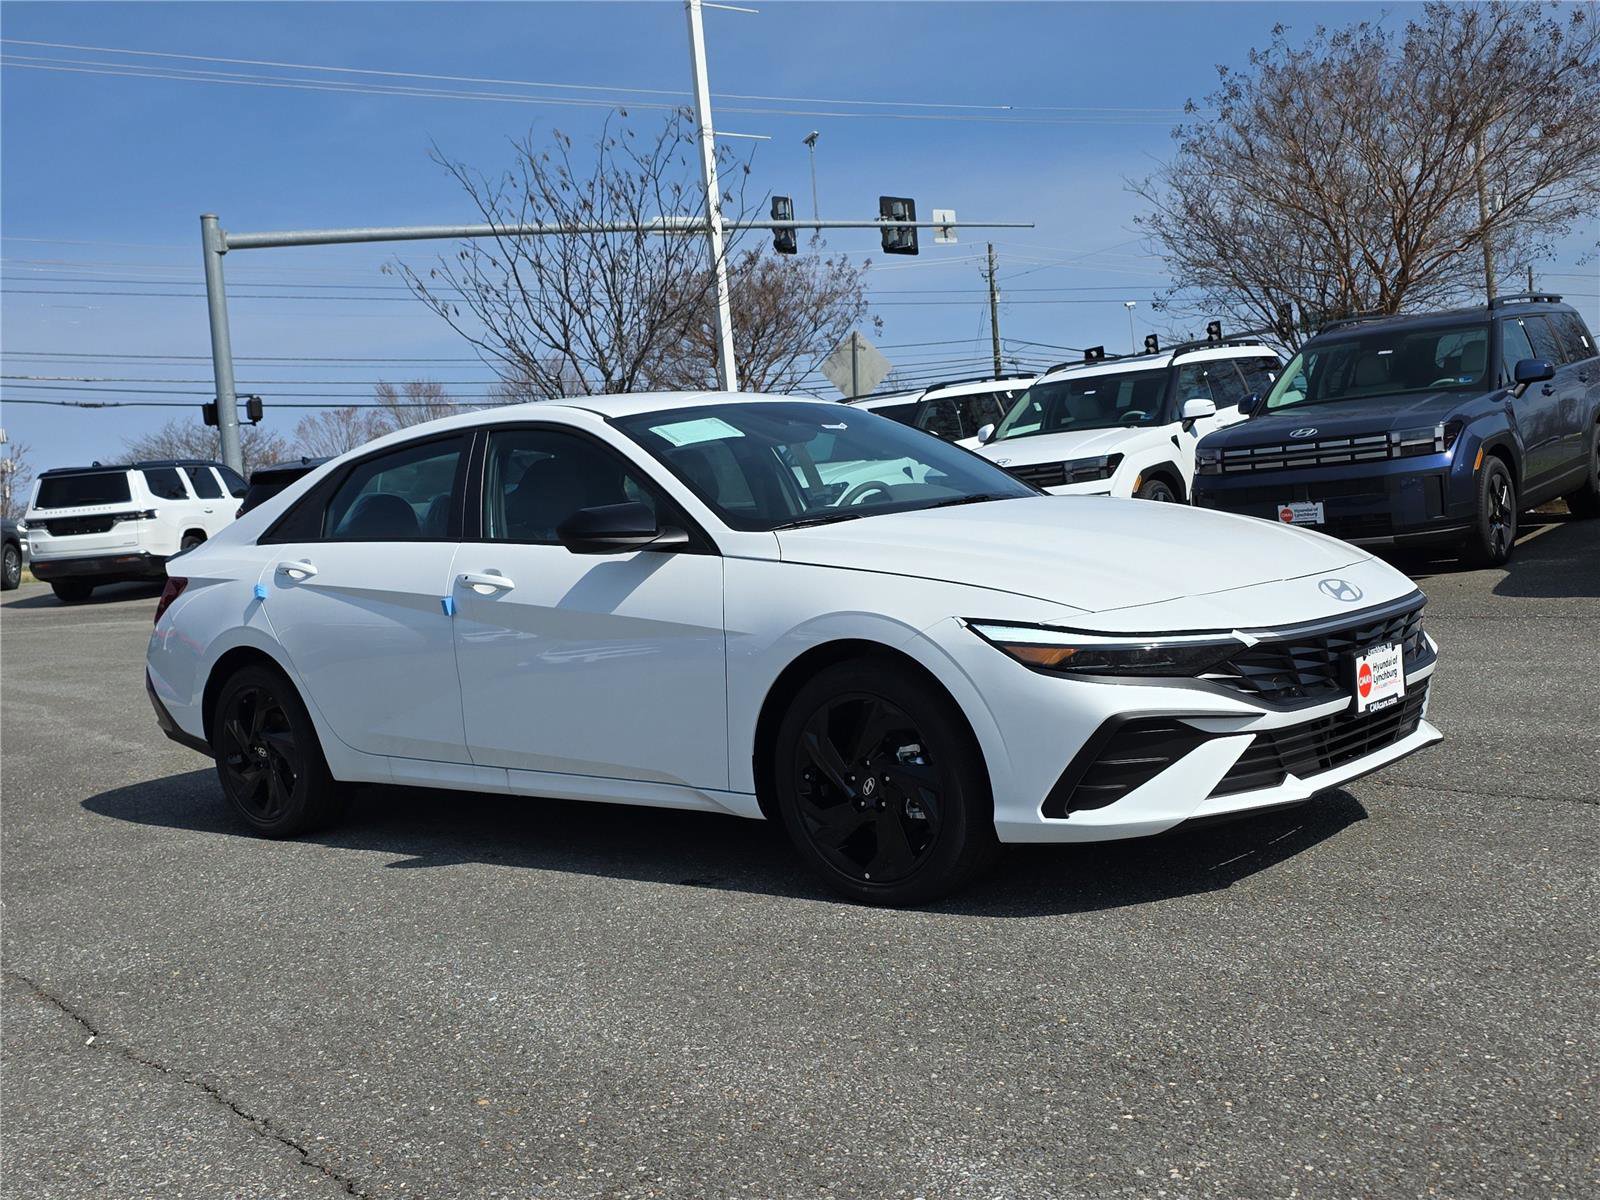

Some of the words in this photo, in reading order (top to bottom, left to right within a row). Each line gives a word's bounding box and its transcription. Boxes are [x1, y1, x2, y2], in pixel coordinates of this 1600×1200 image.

[1373, 658, 1393, 673] Hyundai
[1393, 655, 1398, 665] of
[1373, 668, 1398, 685] Lynchburg
[1369, 697, 1397, 712] CMAcars.com
